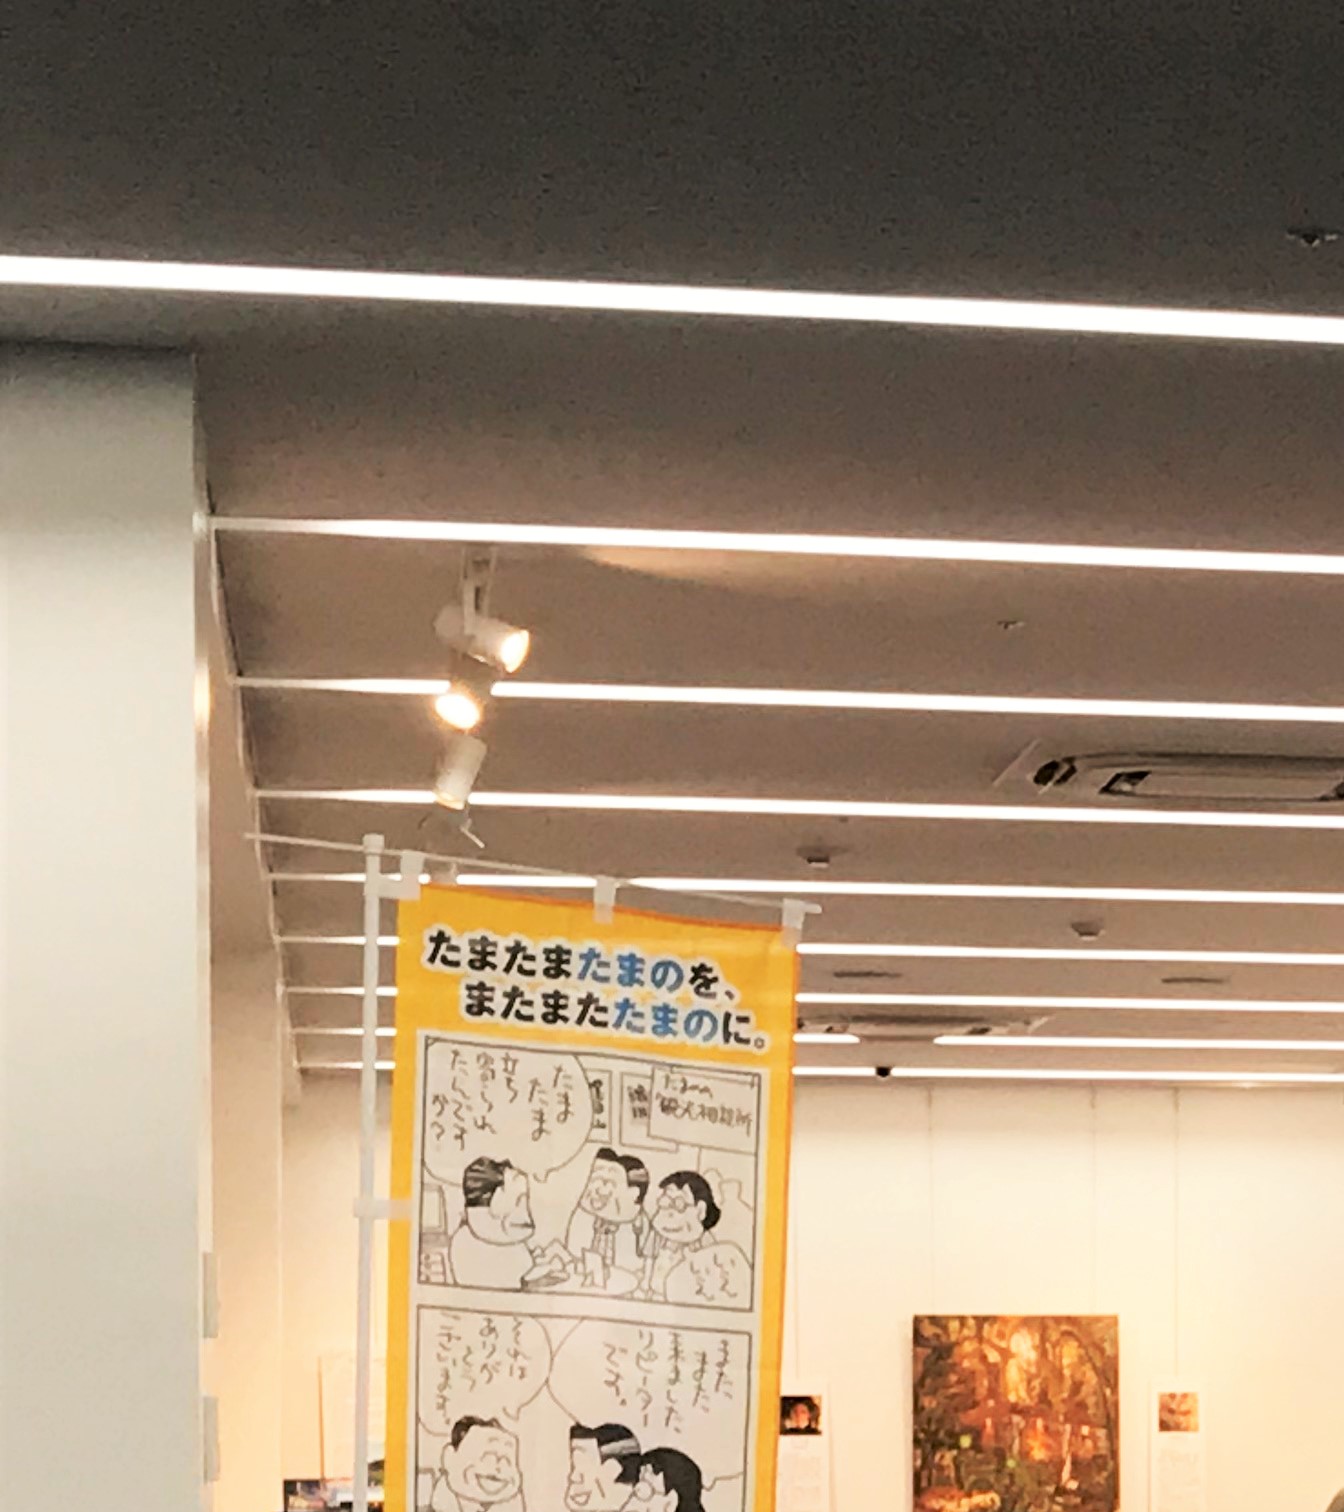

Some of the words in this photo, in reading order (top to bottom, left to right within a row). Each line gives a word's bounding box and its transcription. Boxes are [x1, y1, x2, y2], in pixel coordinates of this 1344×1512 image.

[428, 930, 736, 1000] たまたまたまのを、
[464, 981, 766, 1050] またまたたまのに。
